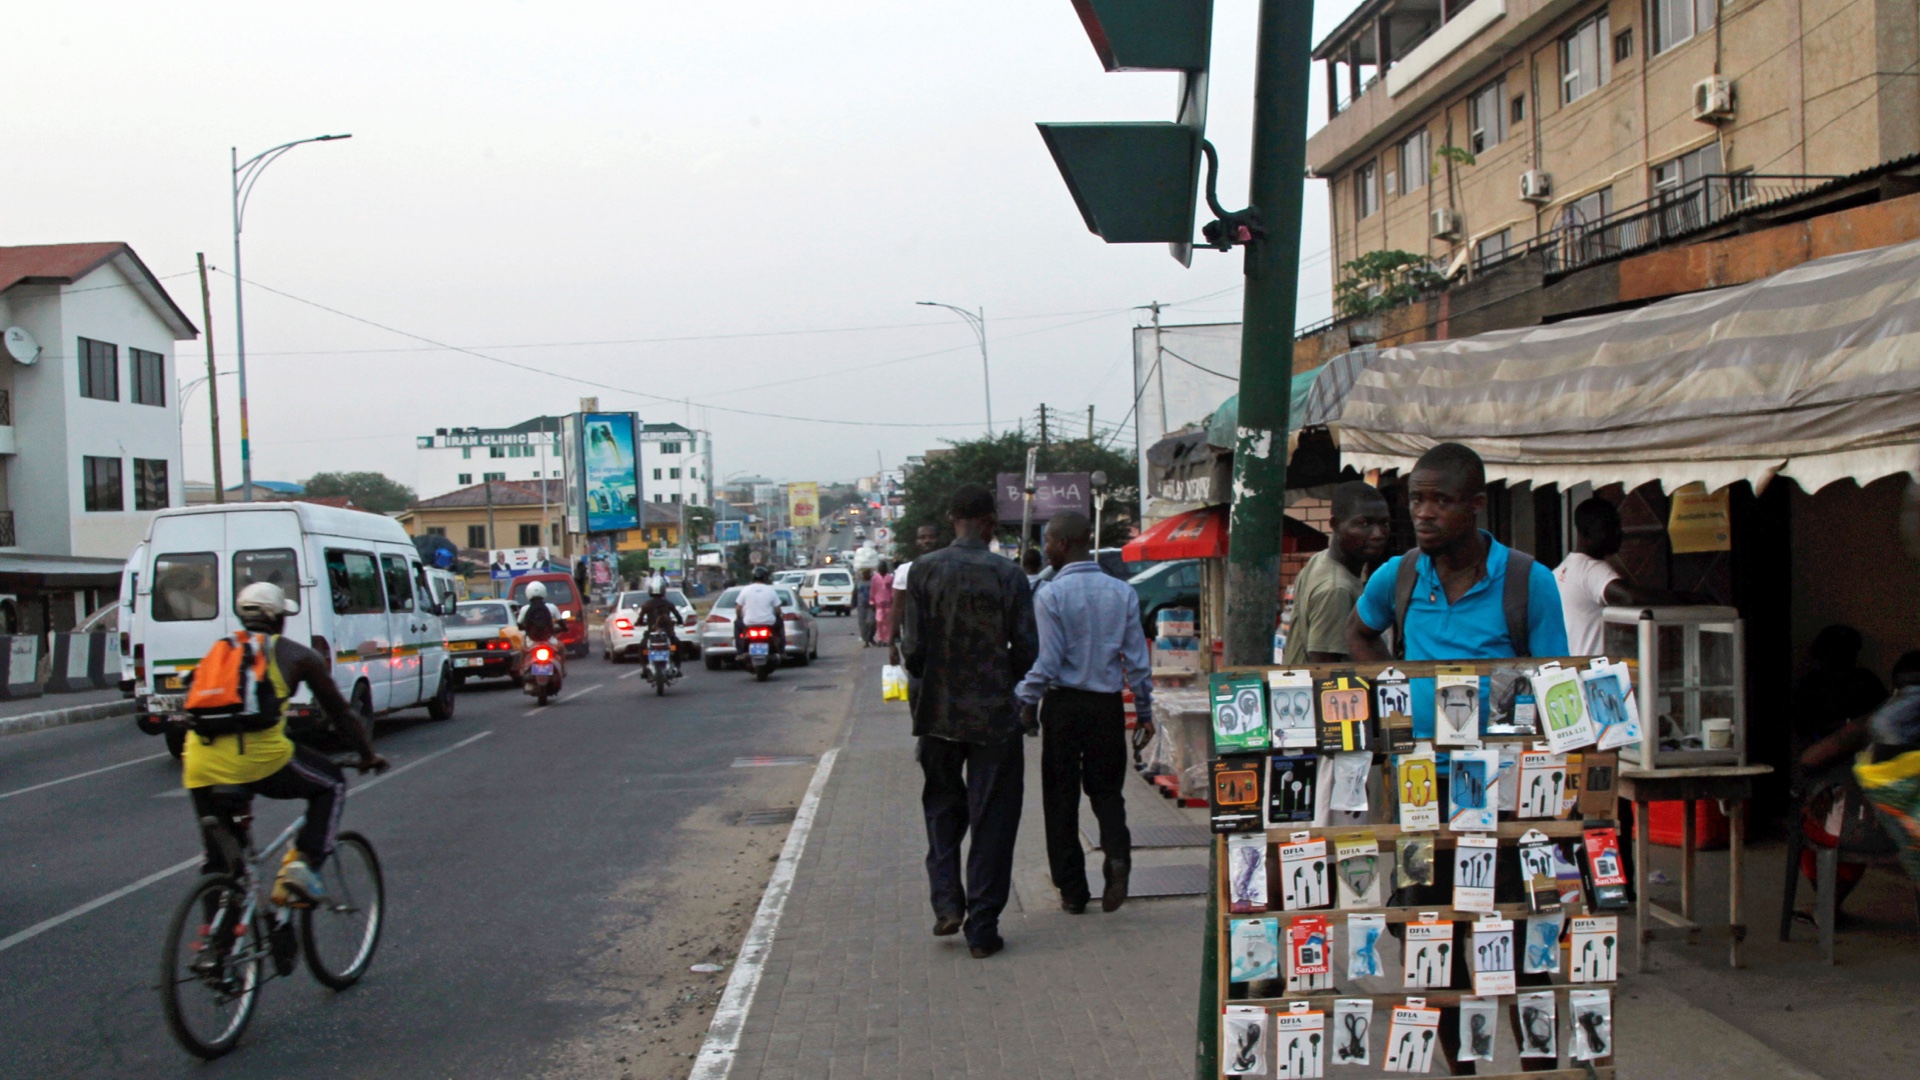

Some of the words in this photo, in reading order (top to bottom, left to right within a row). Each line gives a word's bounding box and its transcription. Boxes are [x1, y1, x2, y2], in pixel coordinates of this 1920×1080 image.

[446, 436, 479, 446] IRAN
[481, 434, 527, 445] CLINIC
[1283, 847, 1304, 855] OFIA
[1595, 877, 1624, 886] SanDisk
[1409, 927, 1431, 935] OFIA
[1295, 965, 1327, 975] SanDisk
[1397, 1011, 1418, 1019] OFIA
